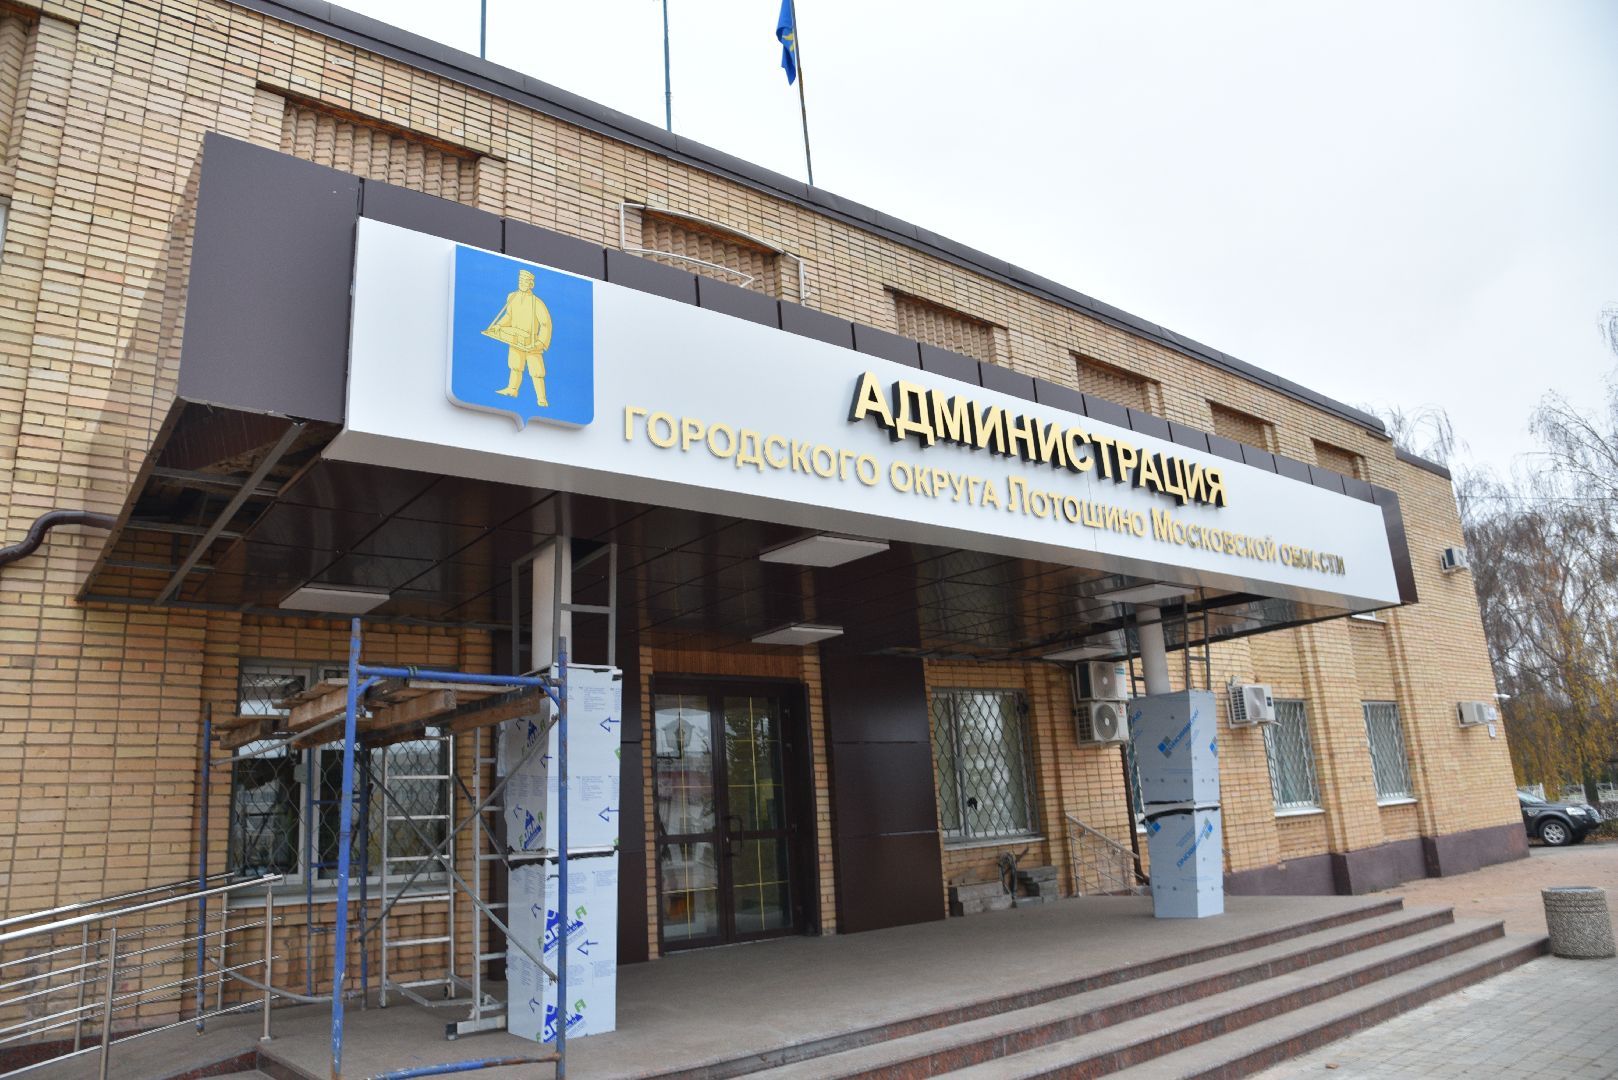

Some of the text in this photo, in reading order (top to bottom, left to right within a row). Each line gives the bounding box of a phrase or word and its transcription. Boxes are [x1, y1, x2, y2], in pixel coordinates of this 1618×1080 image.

[624, 404, 881, 487] ГОРОДСКОГО
[889, 460, 1000, 507] ОКРУГА
[1280, 543, 1345, 575] ОБЛАСТИ
[849, 370, 1229, 508] АДМИНИСТРАЦИЯ
